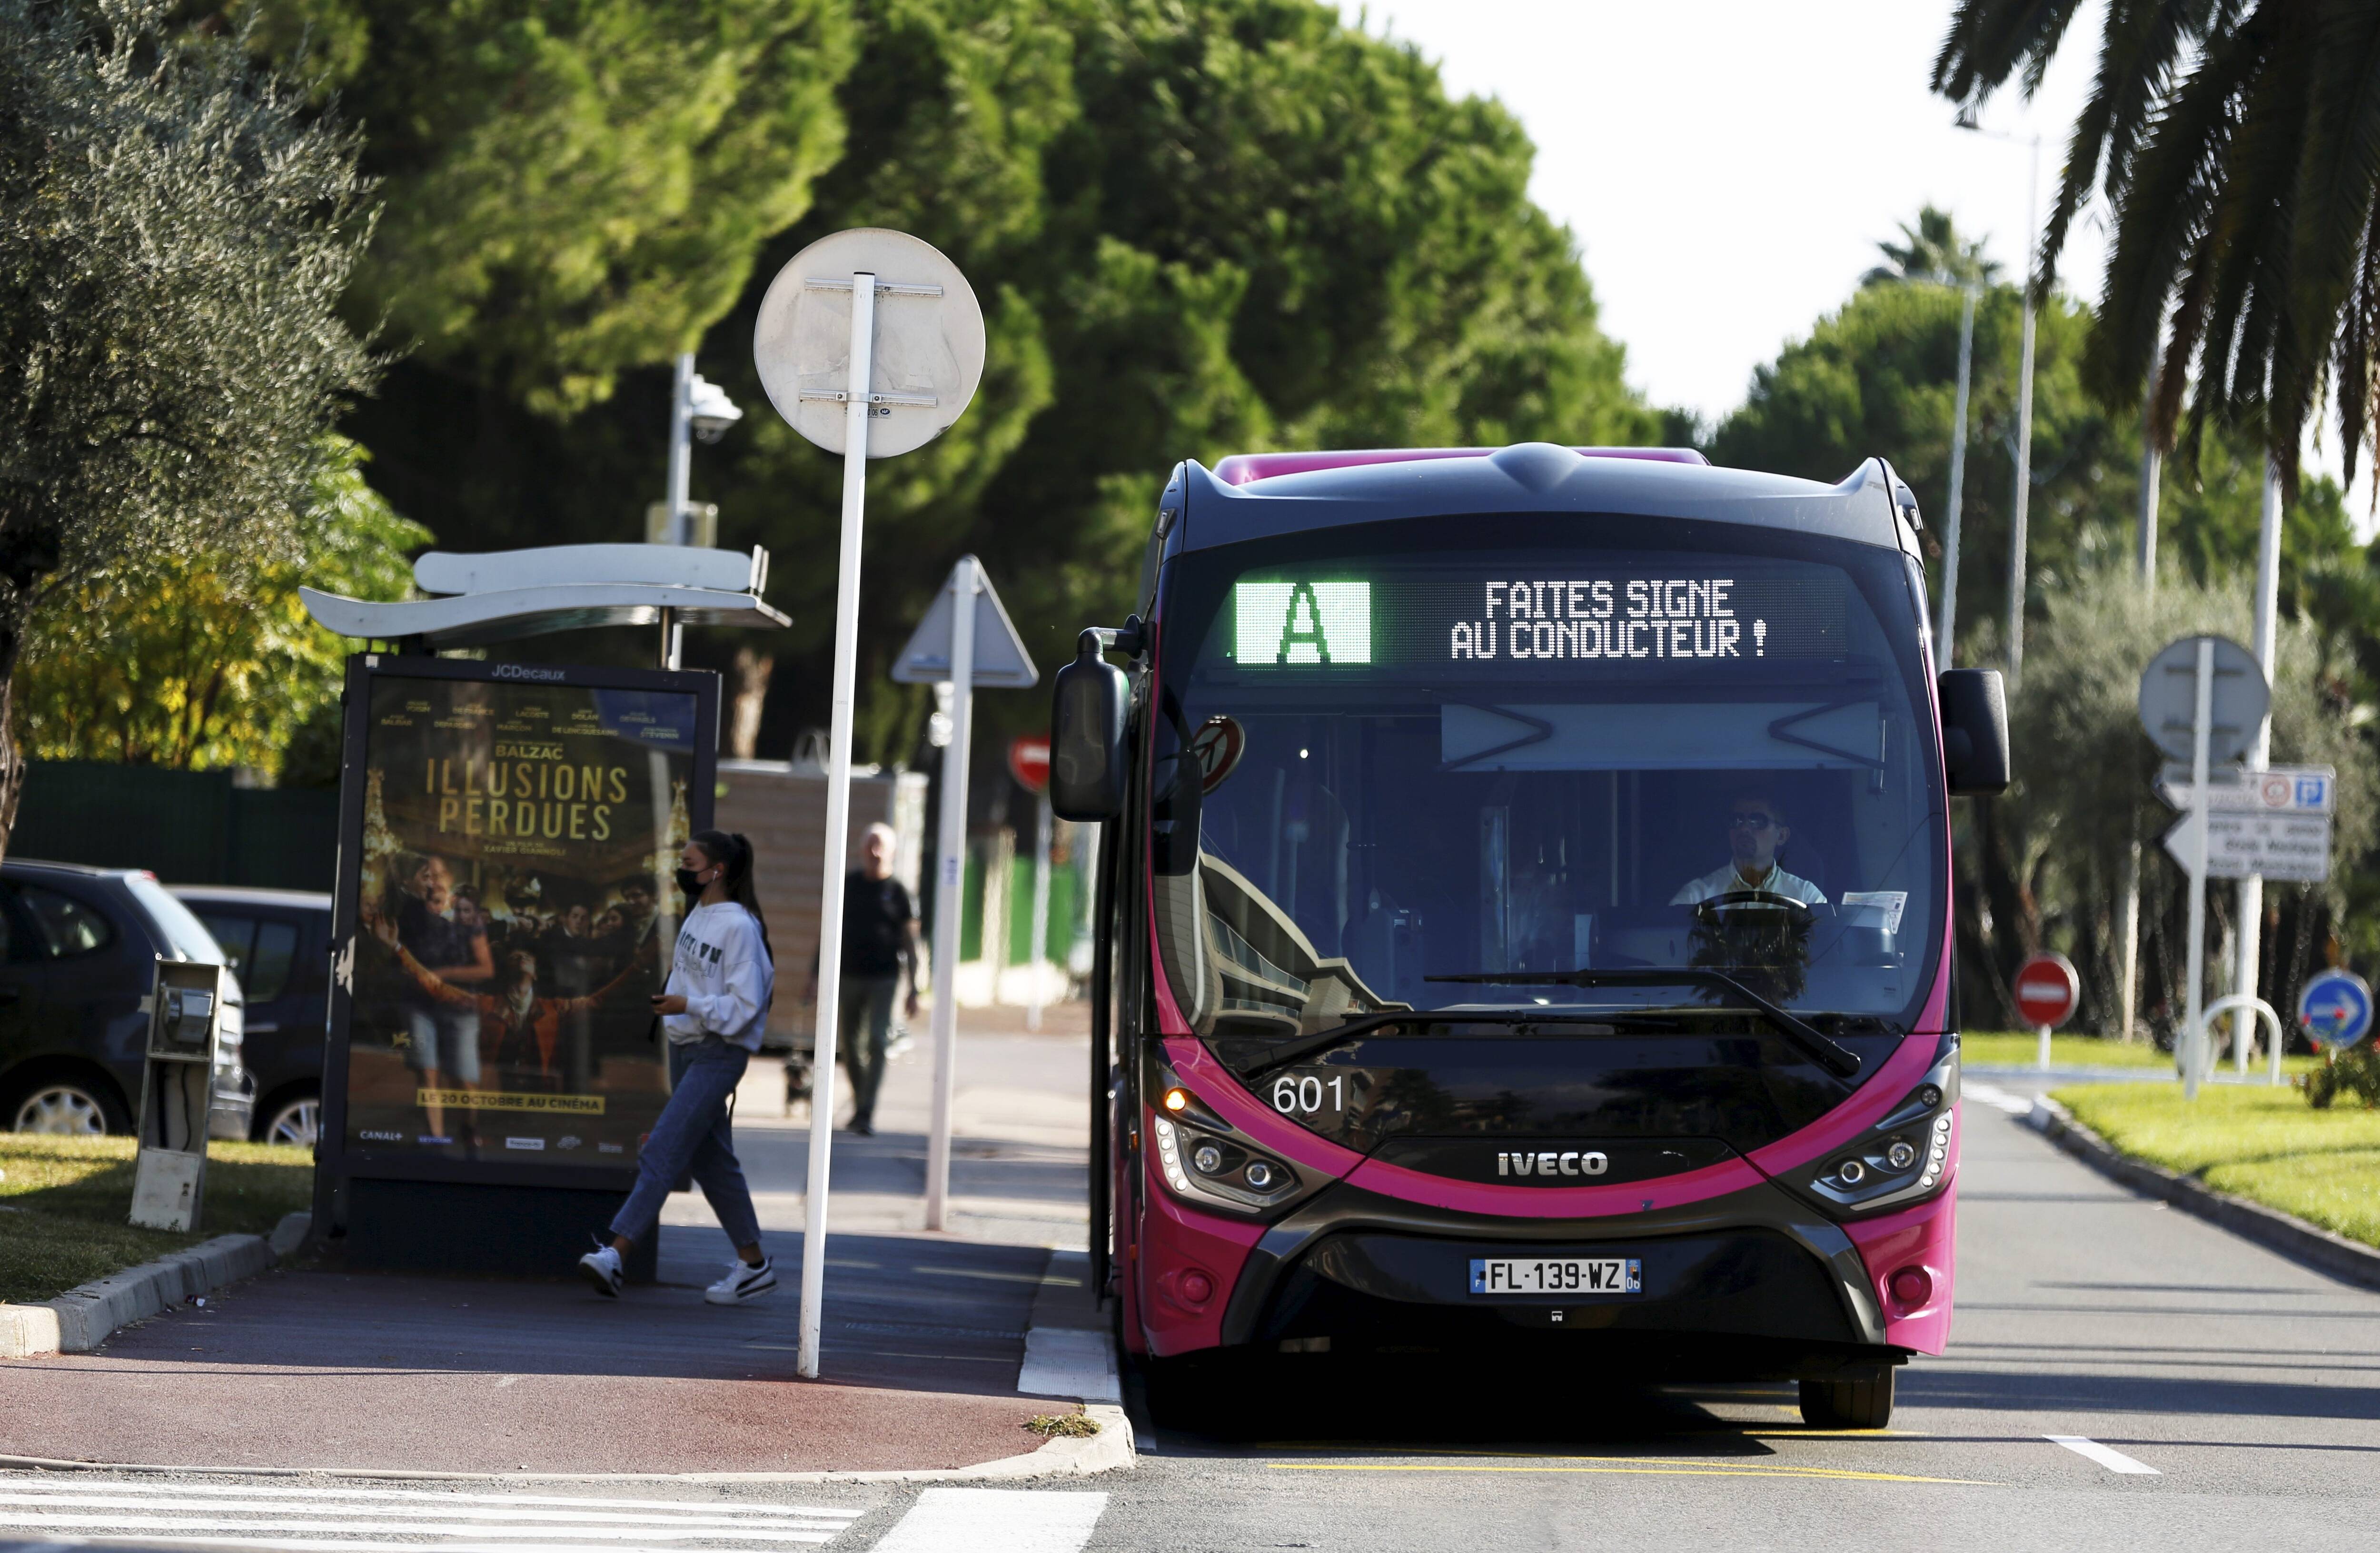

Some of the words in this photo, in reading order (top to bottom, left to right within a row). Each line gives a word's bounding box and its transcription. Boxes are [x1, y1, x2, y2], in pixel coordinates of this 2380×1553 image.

[1485, 581, 1613, 618] FAITES
[1626, 579, 1735, 617] SIGNE
[1277, 582, 1331, 663] A
[1451, 621, 1497, 658] AU
[1508, 621, 1740, 657] CONDUCTEUR
[492, 665, 565, 680] JCDecaux
[495, 745, 564, 760] BALZAC
[426, 758, 628, 804] ILLUSIONS
[438, 798, 611, 842] PERDUES
[421, 1092, 437, 1104] LE
[440, 1093, 456, 1105] 20
[460, 1094, 524, 1108] OCTOBRE
[527, 1096, 546, 1109] AU
[549, 1096, 600, 1112] CINÉMA
[1273, 1075, 1342, 1114] 601
[360, 1131, 403, 1141] CANAL+
[1498, 1151, 1608, 1176] IVECO
[1491, 1263, 1620, 1289] FL-139-WZ
